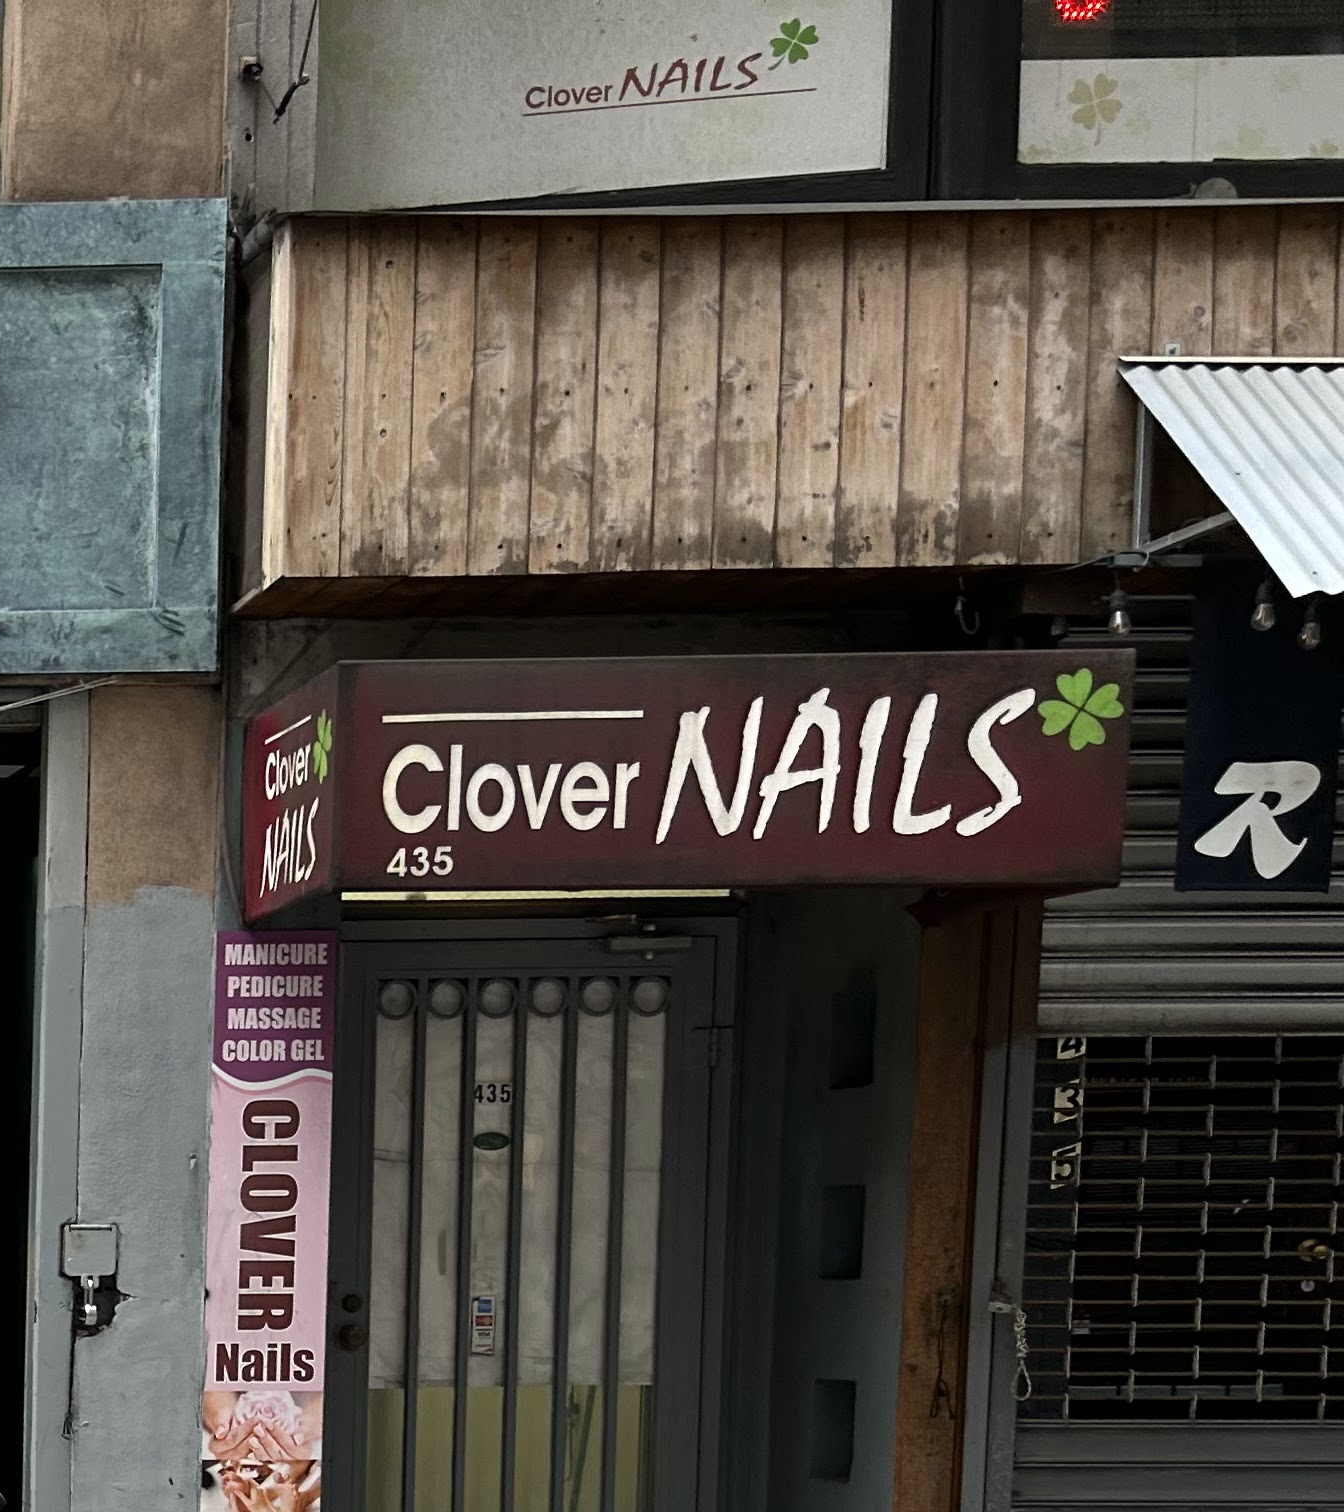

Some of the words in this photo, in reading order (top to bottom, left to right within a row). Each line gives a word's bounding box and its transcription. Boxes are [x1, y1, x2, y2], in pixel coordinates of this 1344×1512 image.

[525, 84, 613, 109] Clover
[619, 52, 762, 101] NAILS
[264, 741, 311, 801] Clover
[382, 744, 640, 834] Clover
[655, 687, 1036, 846] NAILS
[1194, 760, 1322, 880] R
[259, 797, 319, 898] NAILS
[386, 845, 454, 878] 435
[224, 943, 328, 966] MANICURE
[227, 975, 324, 998] PEDICURE
[227, 1007, 321, 1030] MASSAGE
[222, 1039, 286, 1062] COLOR
[290, 1039, 325, 1062] GEL
[474, 1083, 511, 1103] 435
[237, 1099, 302, 1332] CLOVER
[215, 1343, 316, 1383] Nails
